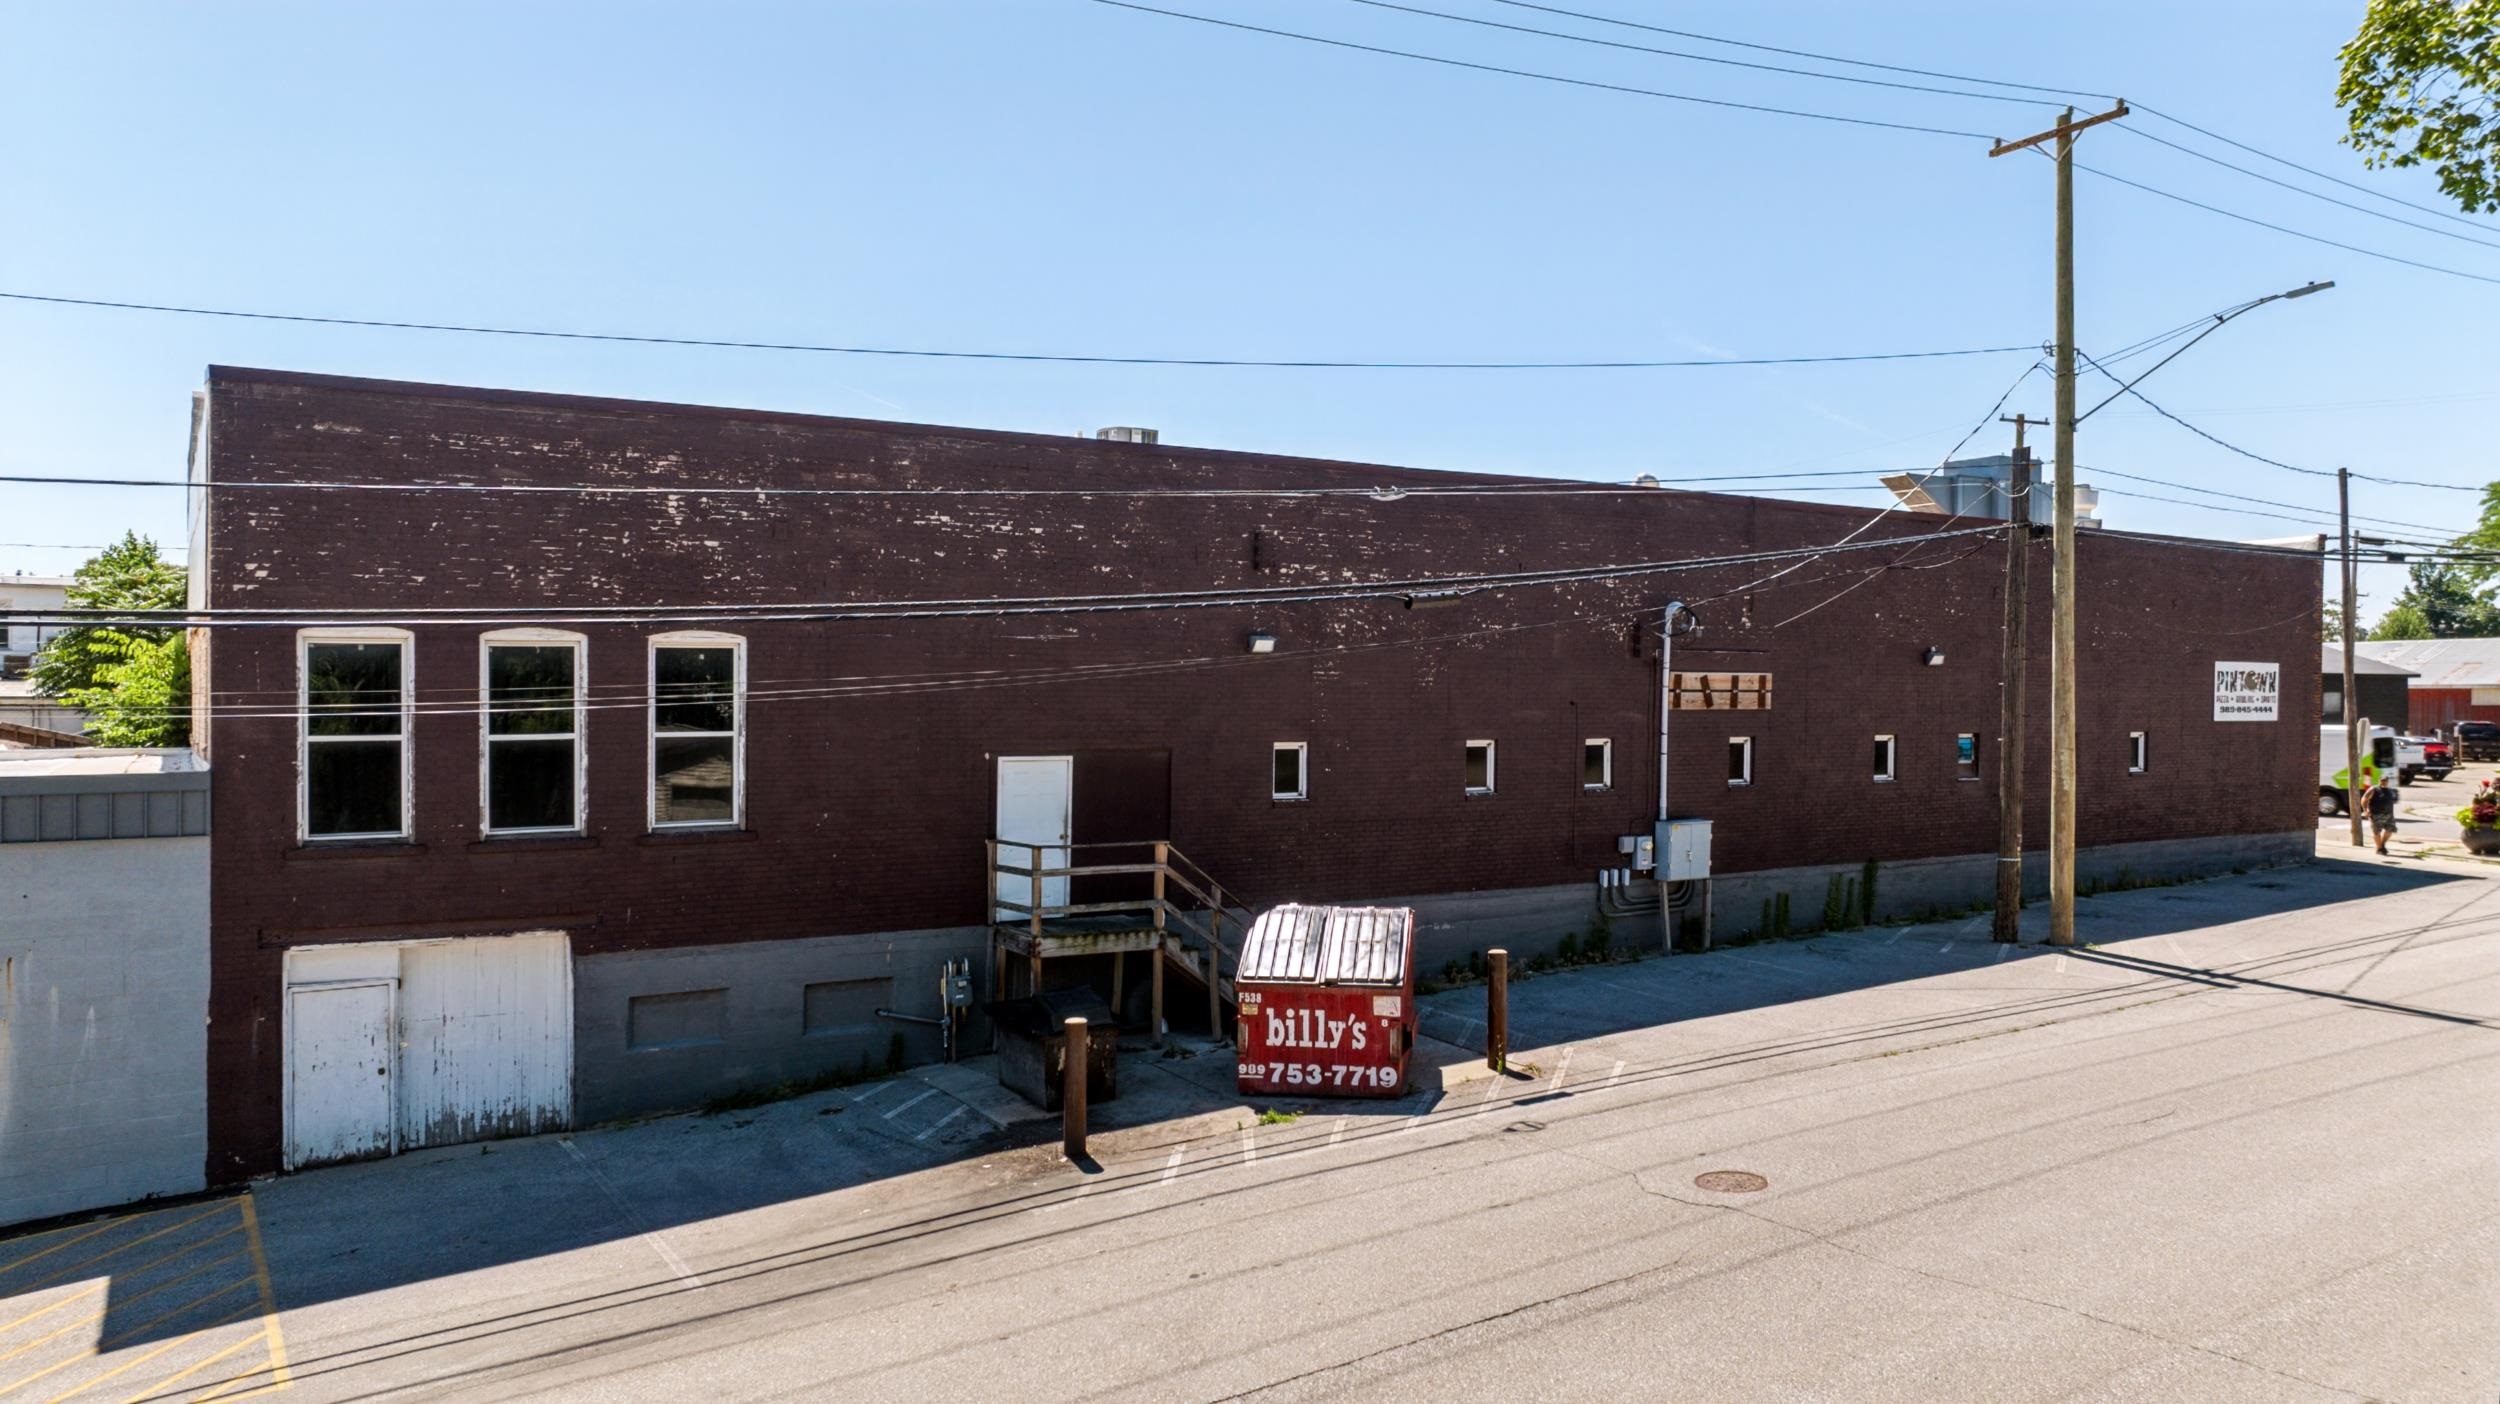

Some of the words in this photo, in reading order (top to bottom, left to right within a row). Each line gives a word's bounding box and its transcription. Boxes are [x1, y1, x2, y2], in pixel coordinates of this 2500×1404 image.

[1238, 992, 1262, 1003] F538
[1265, 1007, 1367, 1050] billy's
[1238, 1063, 1266, 1075] 989
[1269, 1062, 1398, 1088] 753-7719
